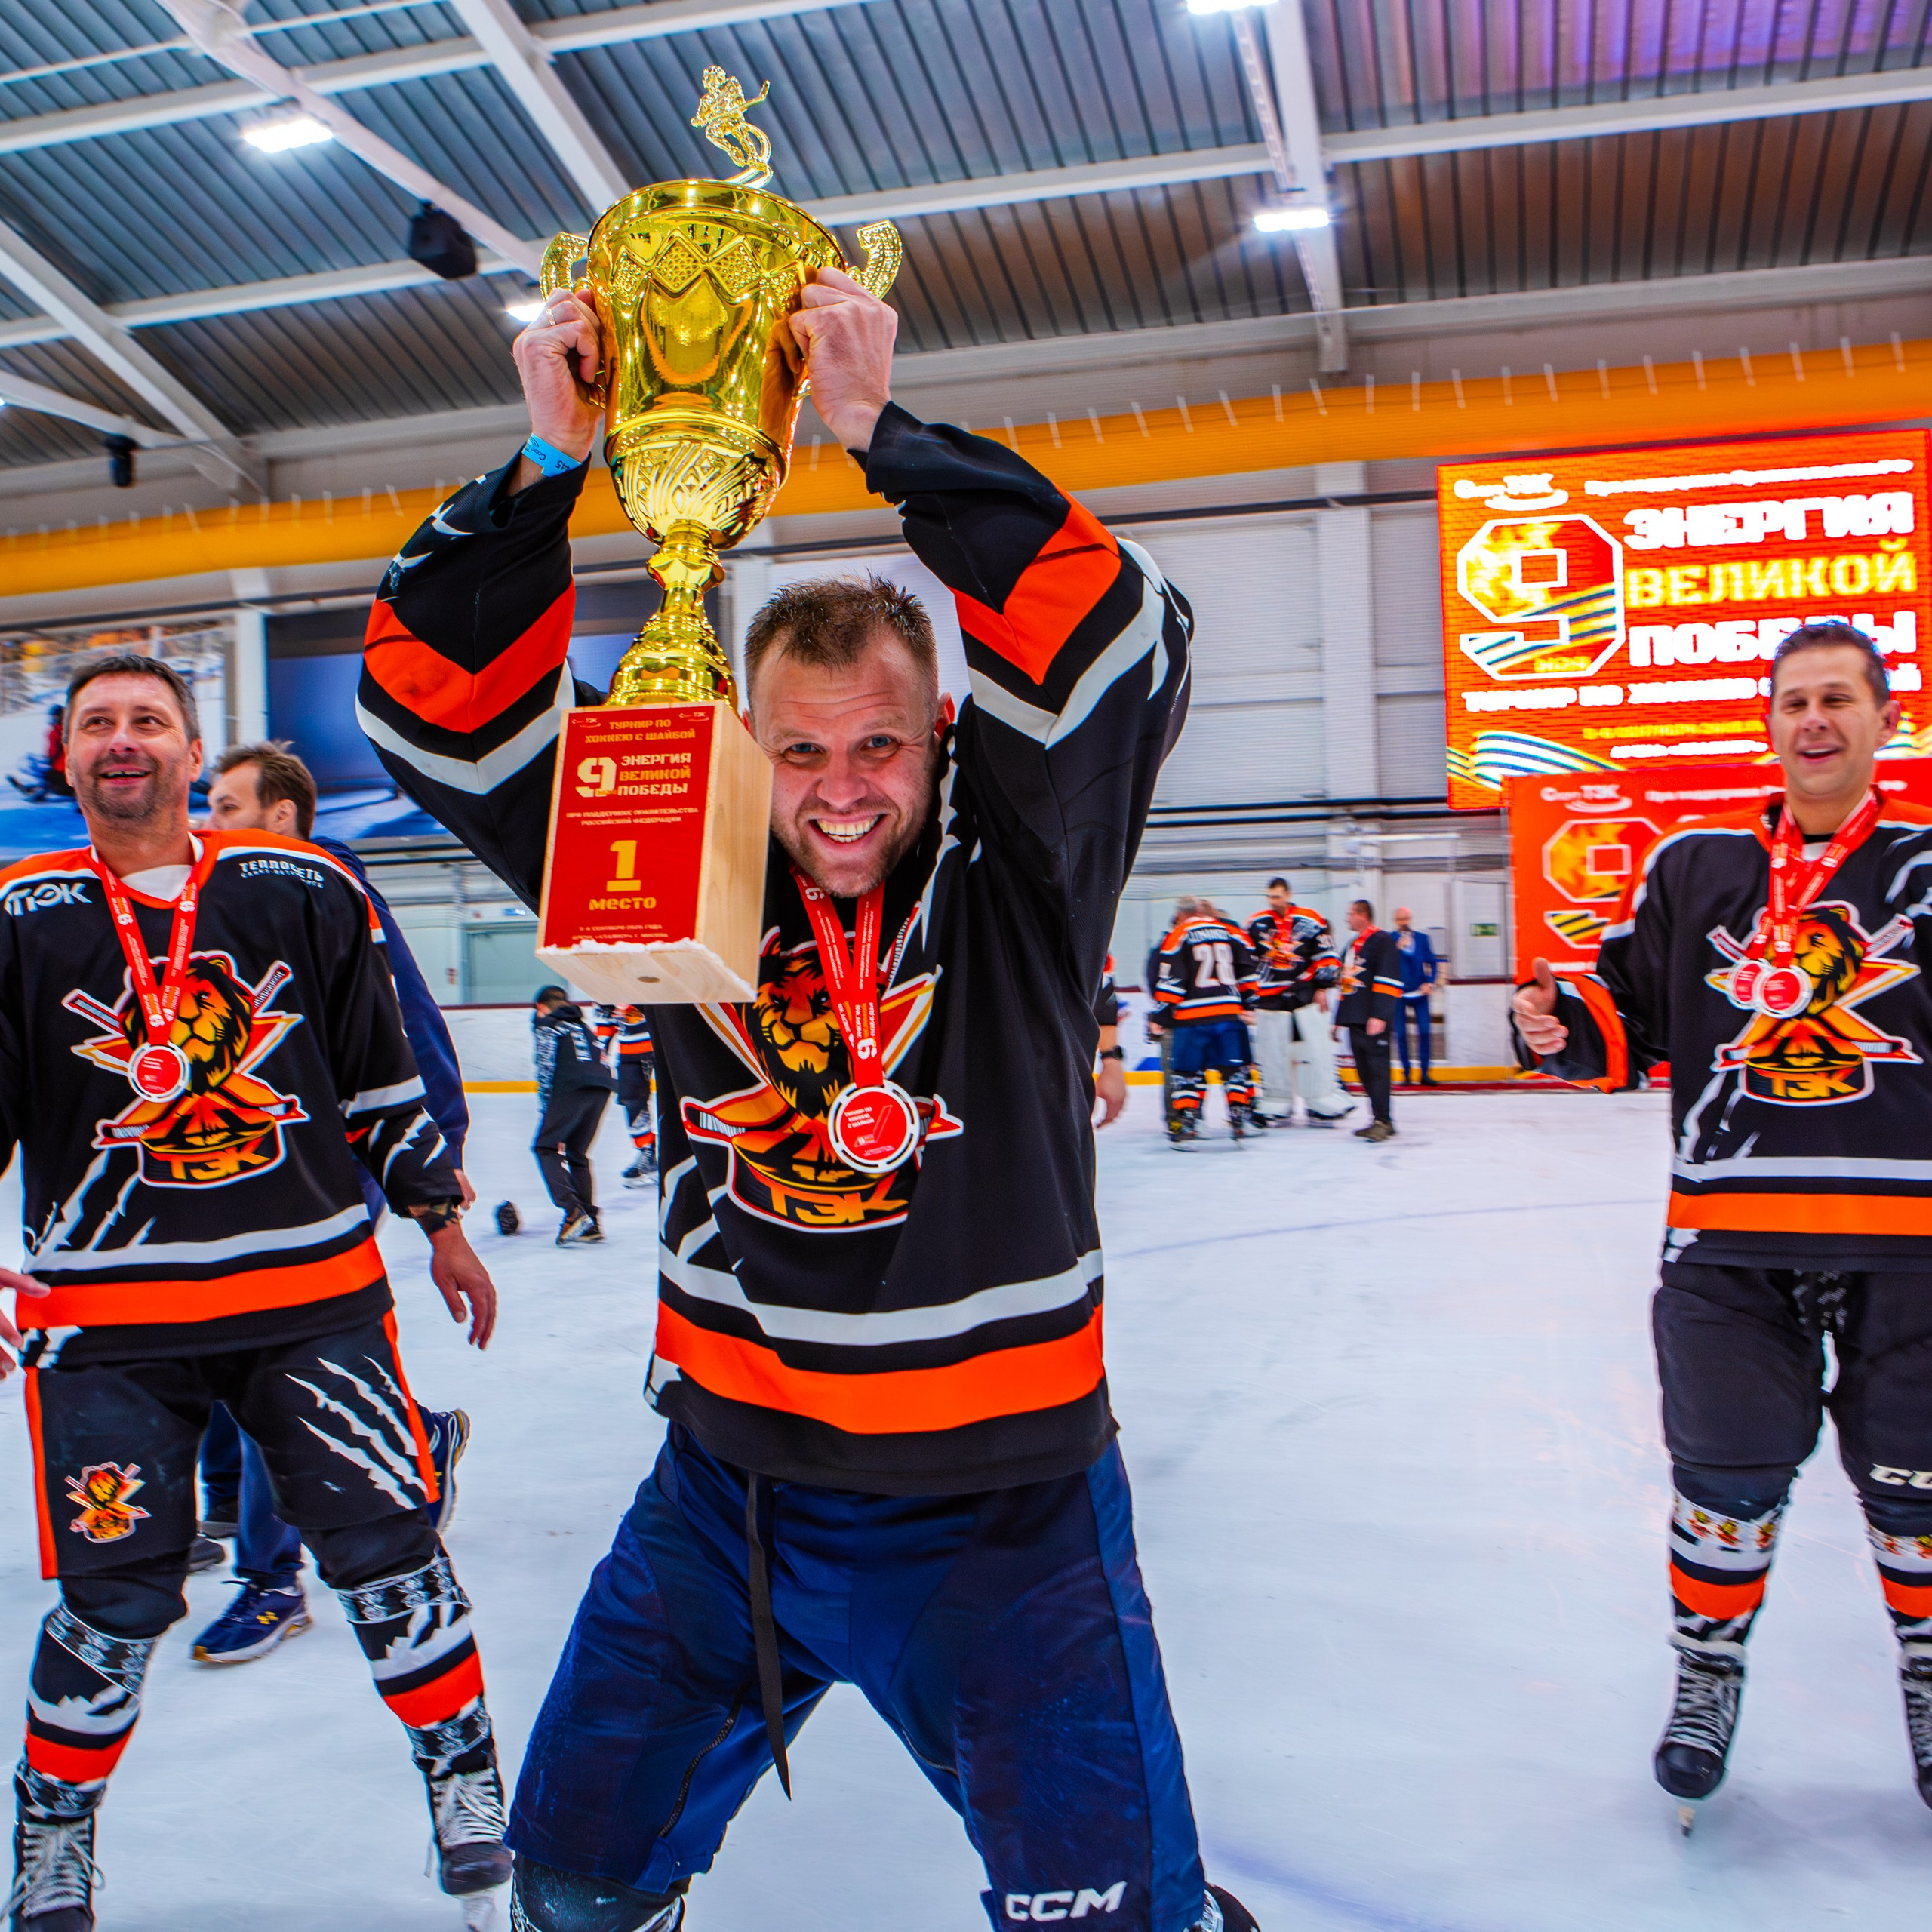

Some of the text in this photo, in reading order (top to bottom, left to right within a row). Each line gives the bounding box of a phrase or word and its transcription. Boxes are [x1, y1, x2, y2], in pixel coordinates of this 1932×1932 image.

[1623, 491, 1915, 550] ЭНЕРГИЯ
[1626, 538, 1918, 608] ВЕЛИКОЙ
[655, 719, 672, 728] ПО
[575, 756, 617, 798] 9
[619, 765, 691, 782] ВЕЛИКОЙ
[621, 753, 691, 766] ЭНЕРГИЯ
[617, 783, 688, 796] ПОБЕДЫ
[606, 840, 642, 892] 1
[1192, 942, 1238, 989] 28
[1005, 1880, 1128, 1921] CCM
